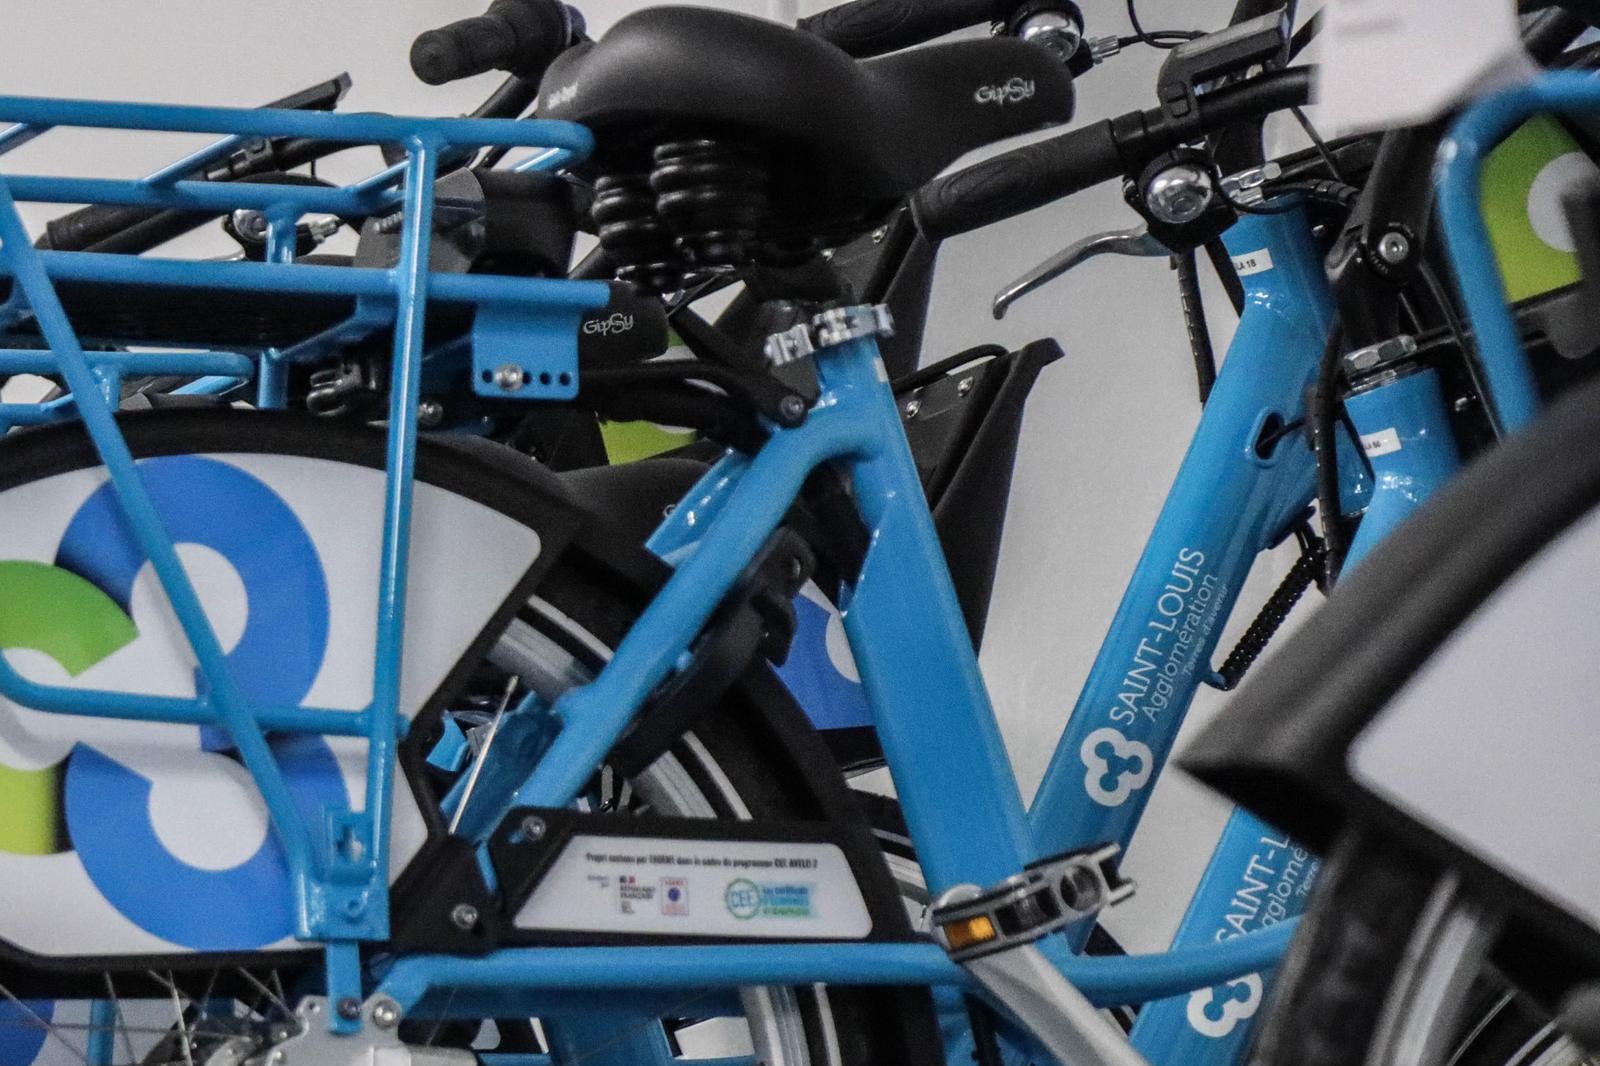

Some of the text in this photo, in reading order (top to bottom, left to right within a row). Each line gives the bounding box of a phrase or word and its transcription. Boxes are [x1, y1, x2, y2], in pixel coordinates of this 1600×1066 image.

[1109, 547, 1205, 725] SAINT-LOUIS
[1141, 574, 1218, 723] Agglomération
[1261, 847, 1309, 930] gglomé
